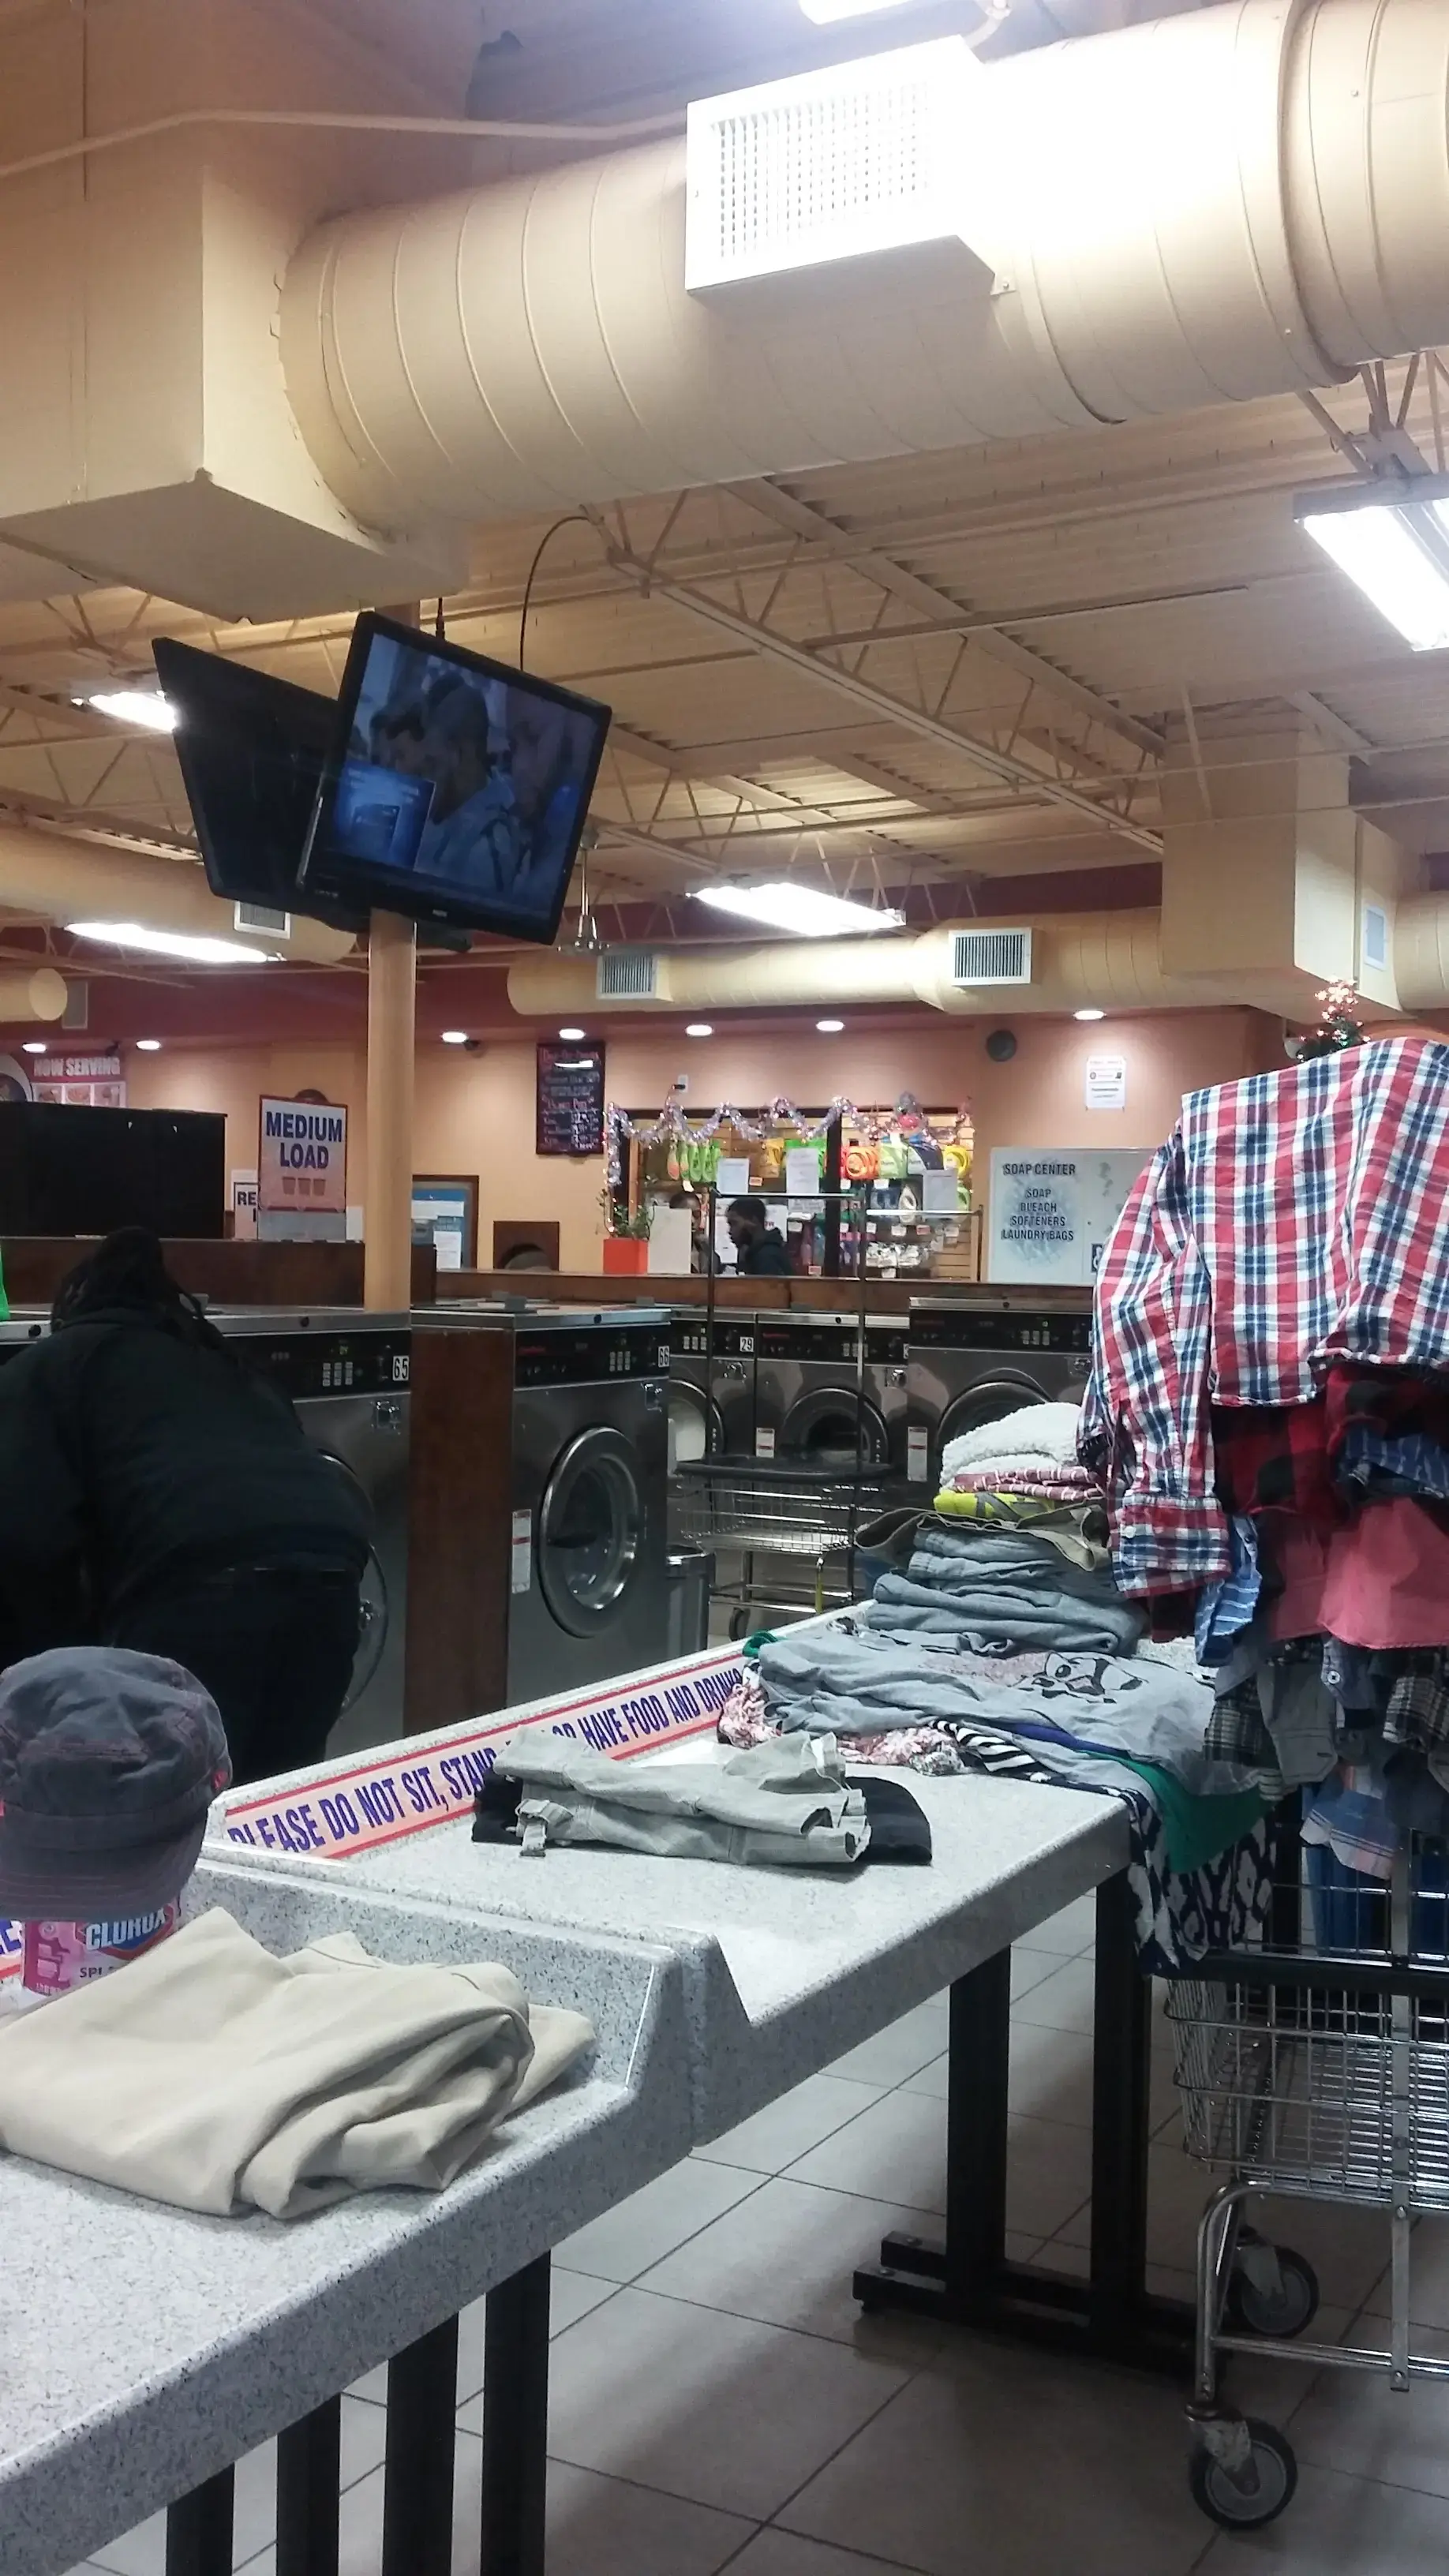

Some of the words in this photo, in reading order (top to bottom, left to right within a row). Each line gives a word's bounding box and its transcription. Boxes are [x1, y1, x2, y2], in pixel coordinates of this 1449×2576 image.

[33, 1058, 64, 1076] NOW
[66, 1057, 120, 1076] SERVING
[266, 1111, 343, 1143] MEDIUM
[279, 1142, 329, 1170] LOAD
[1003, 1163, 1032, 1175] SOAP
[1035, 1163, 1076, 1175] CENTER
[1026, 1188, 1051, 1198] SOAP
[1020, 1202, 1057, 1212] BLEACH
[1011, 1215, 1065, 1226] SOFTENERS
[1002, 1229, 1046, 1240] LAUNDRY
[1047, 1230, 1074, 1241] BAGS
[741, 1339, 753, 1352] 29
[659, 1347, 668, 1365] 66
[395, 1357, 408, 1379] 65
[318, 1793, 360, 1840] DO
[354, 1777, 406, 1829] NOT
[401, 1766, 449, 1812] SIT,
[577, 1708, 629, 1751] HAVE
[620, 1694, 670, 1739] FOOD
[663, 1684, 702, 1724] AND
